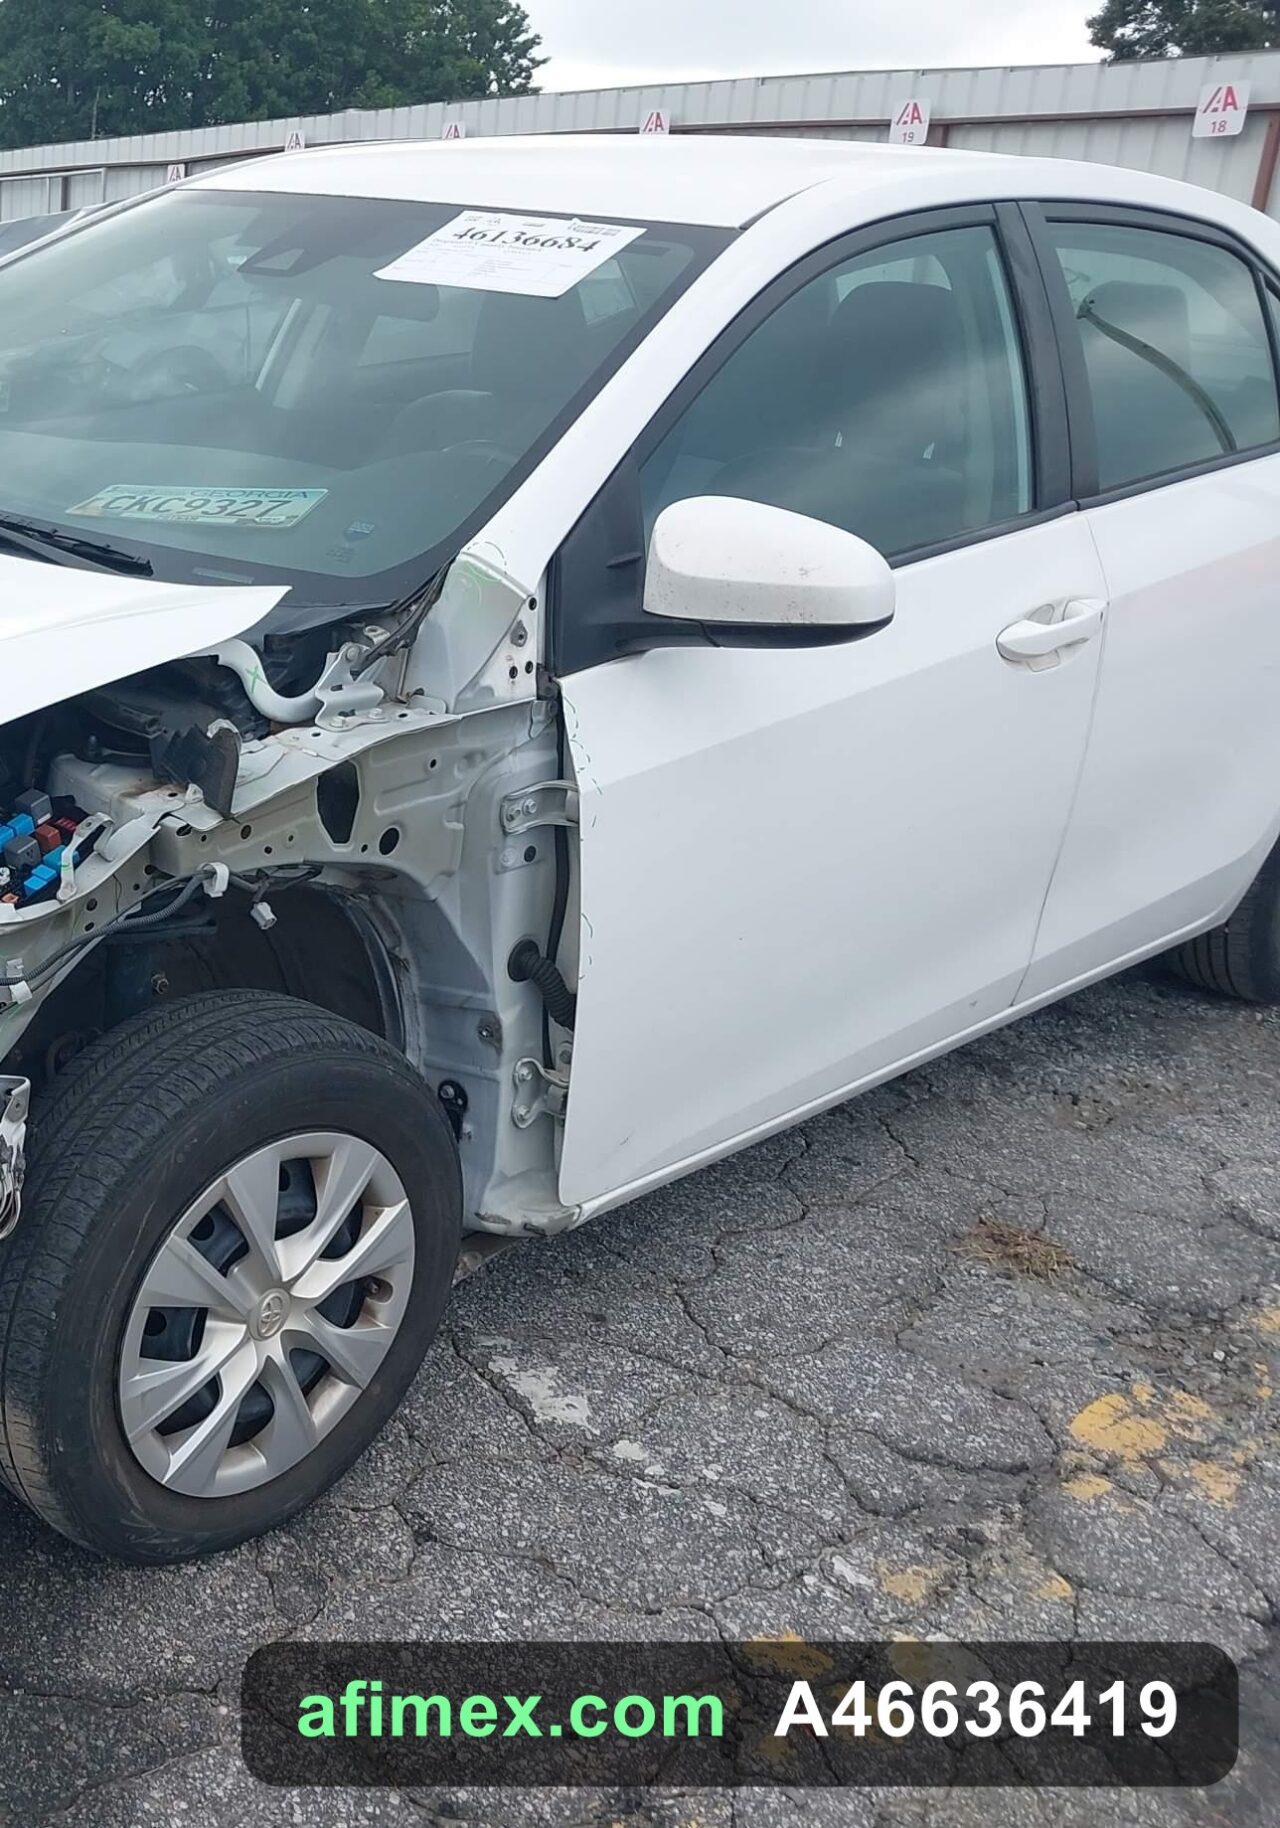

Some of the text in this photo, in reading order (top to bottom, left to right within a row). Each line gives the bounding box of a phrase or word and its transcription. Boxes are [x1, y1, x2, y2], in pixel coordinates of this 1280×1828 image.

[1211, 120, 1227, 133] 18
[902, 132, 914, 143] 19
[453, 227, 602, 253] 46136684
[190, 489, 308, 499] GEORGIA
[103, 494, 293, 518] CKC9327
